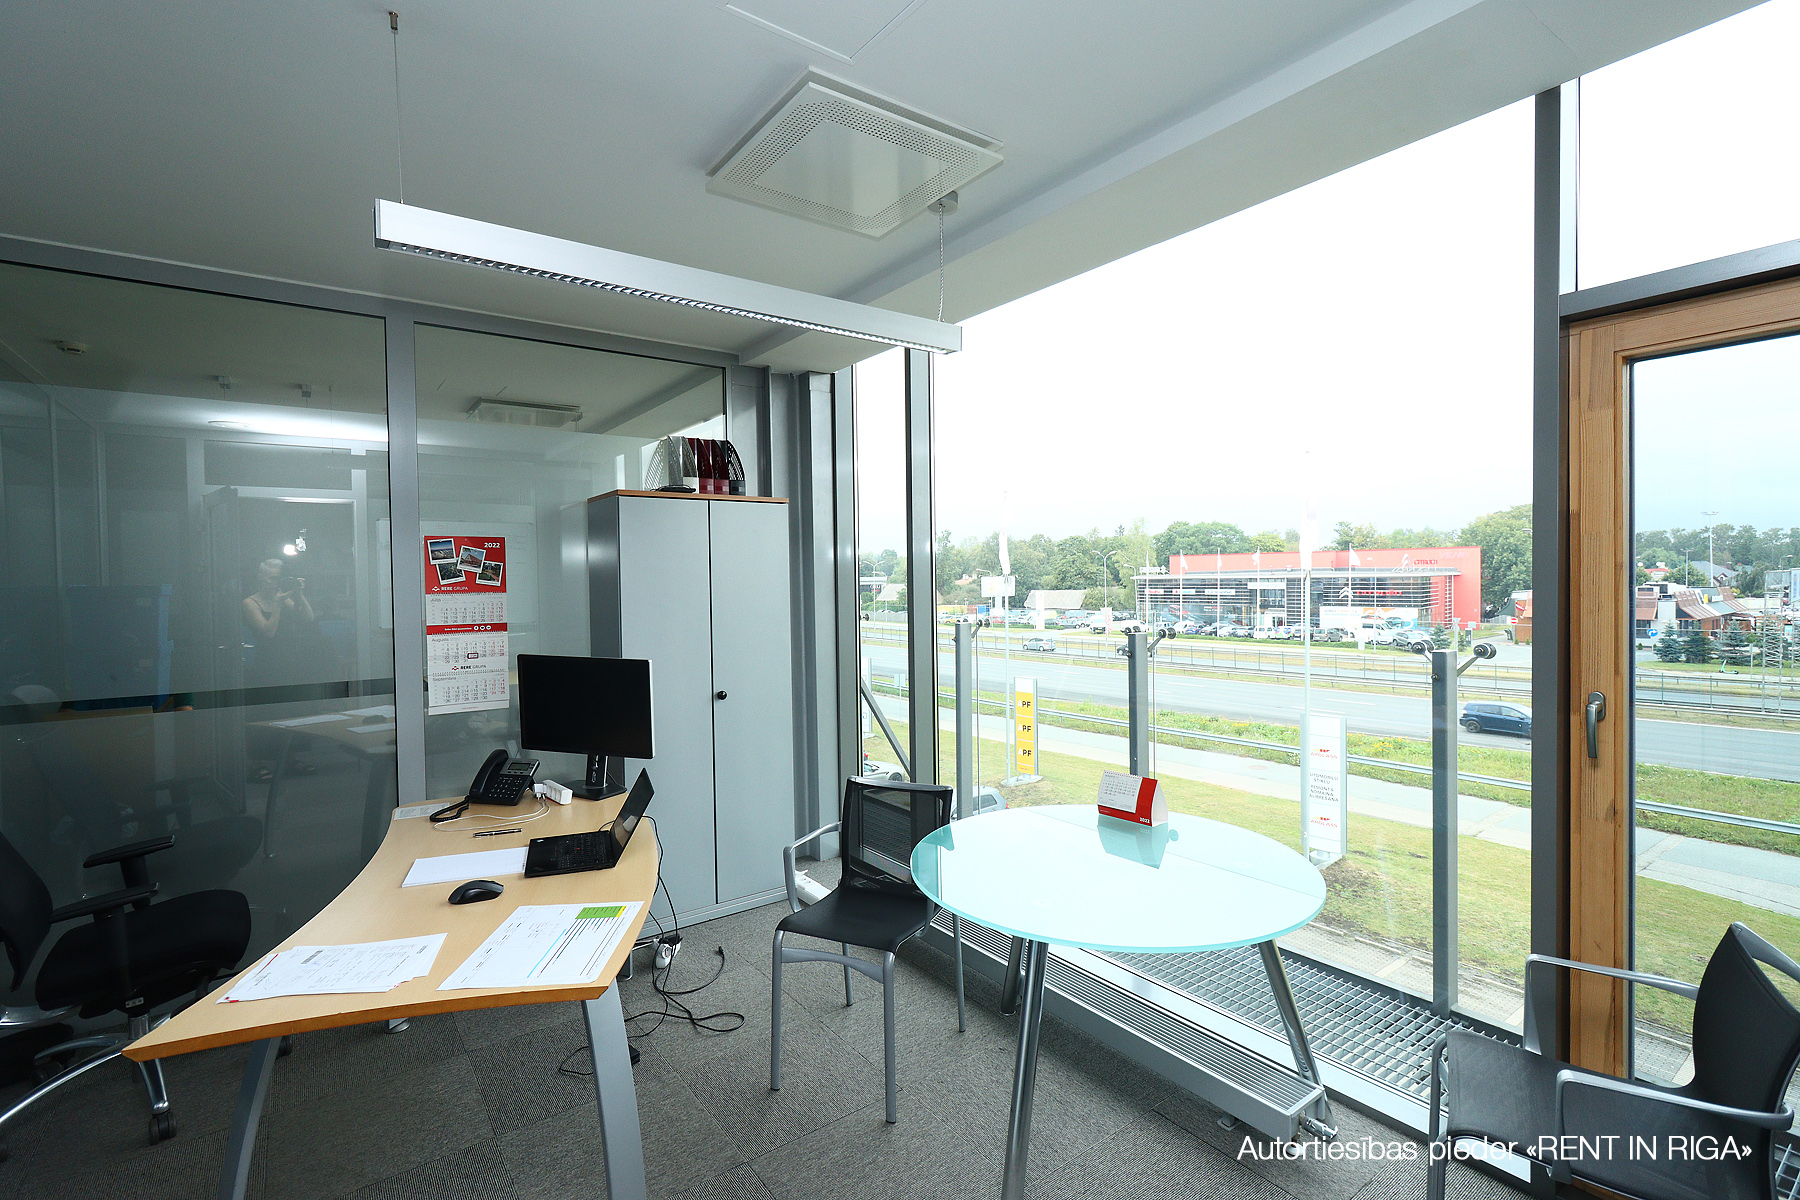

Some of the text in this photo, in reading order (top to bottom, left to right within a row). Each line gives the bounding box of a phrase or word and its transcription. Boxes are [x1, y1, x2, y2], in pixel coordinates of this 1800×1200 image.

[1017, 700, 1031, 708] APF
[1017, 724, 1032, 732] APF
[1018, 748, 1032, 757] APF
[1310, 819, 1338, 828] ARGLASS
